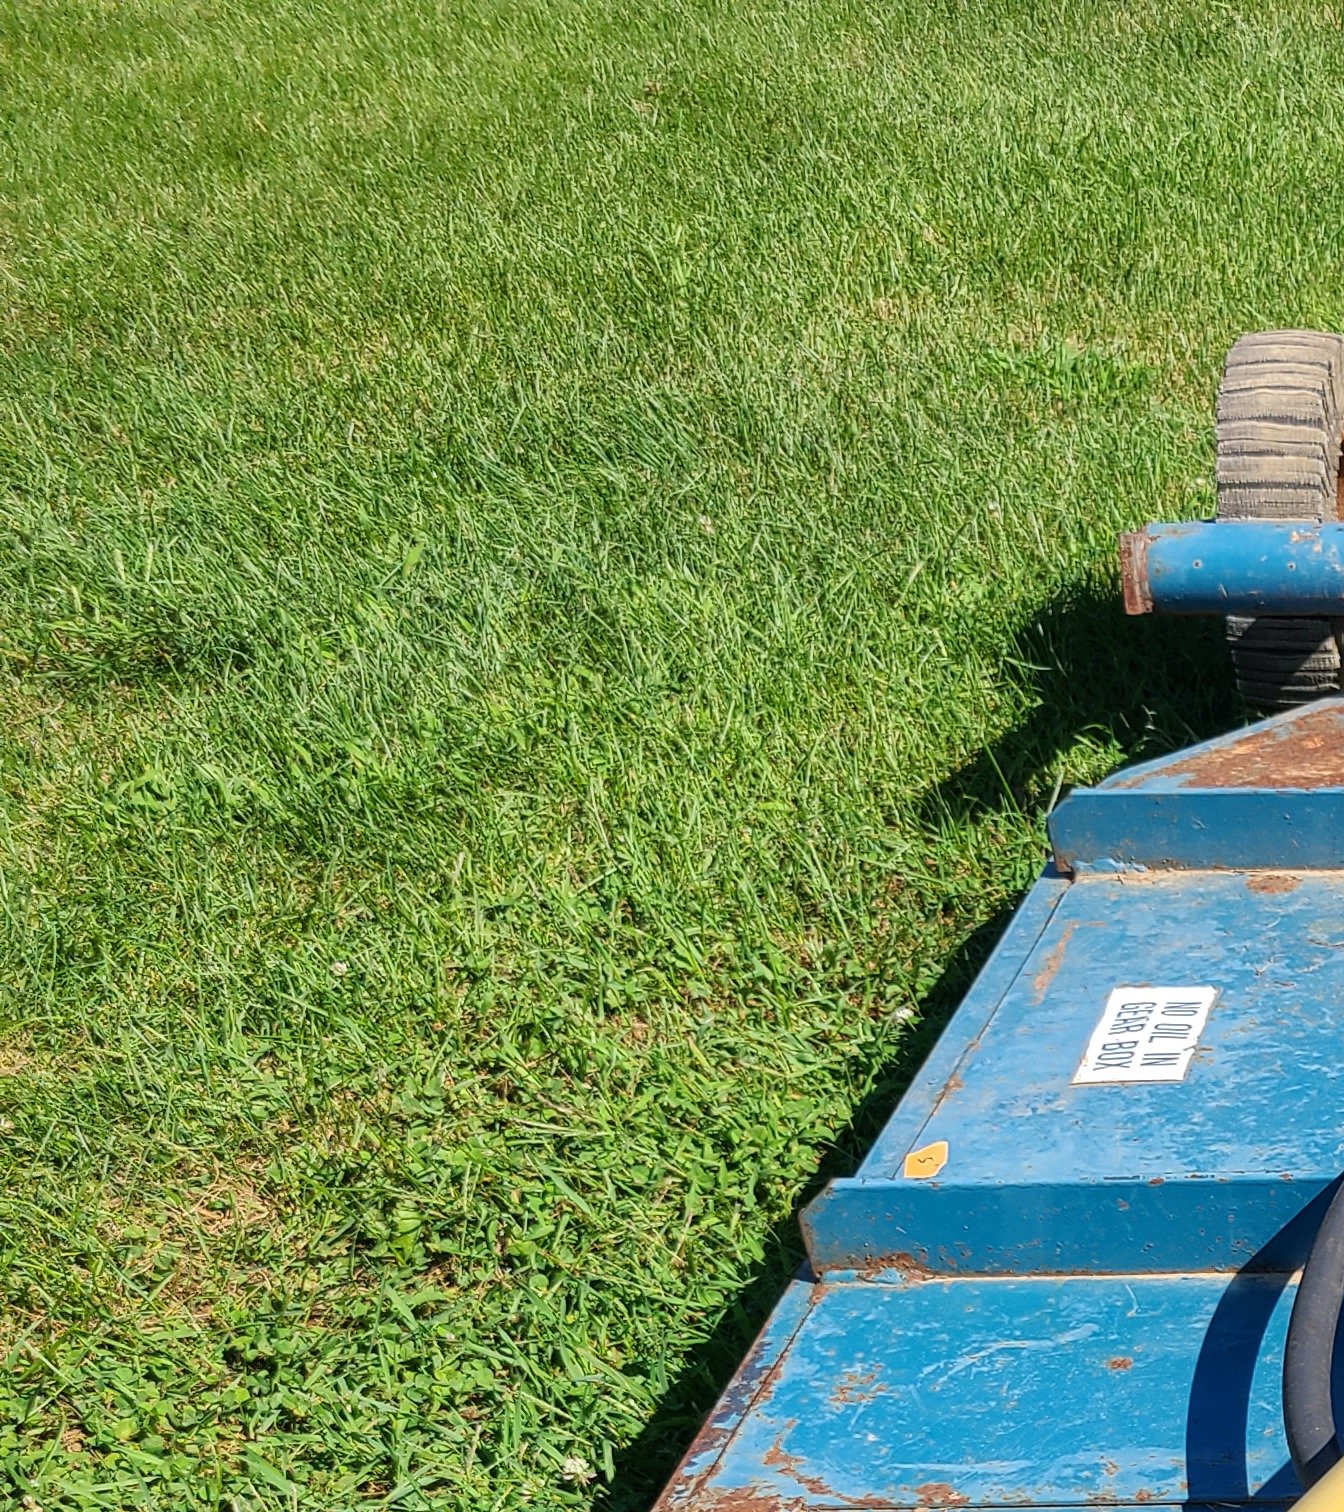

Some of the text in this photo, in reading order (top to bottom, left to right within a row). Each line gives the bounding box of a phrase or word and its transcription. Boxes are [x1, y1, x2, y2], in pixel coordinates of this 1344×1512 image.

[1092, 1001, 1157, 1072] GEAR BOX
[1139, 1001, 1203, 1067] NO OIL IN
